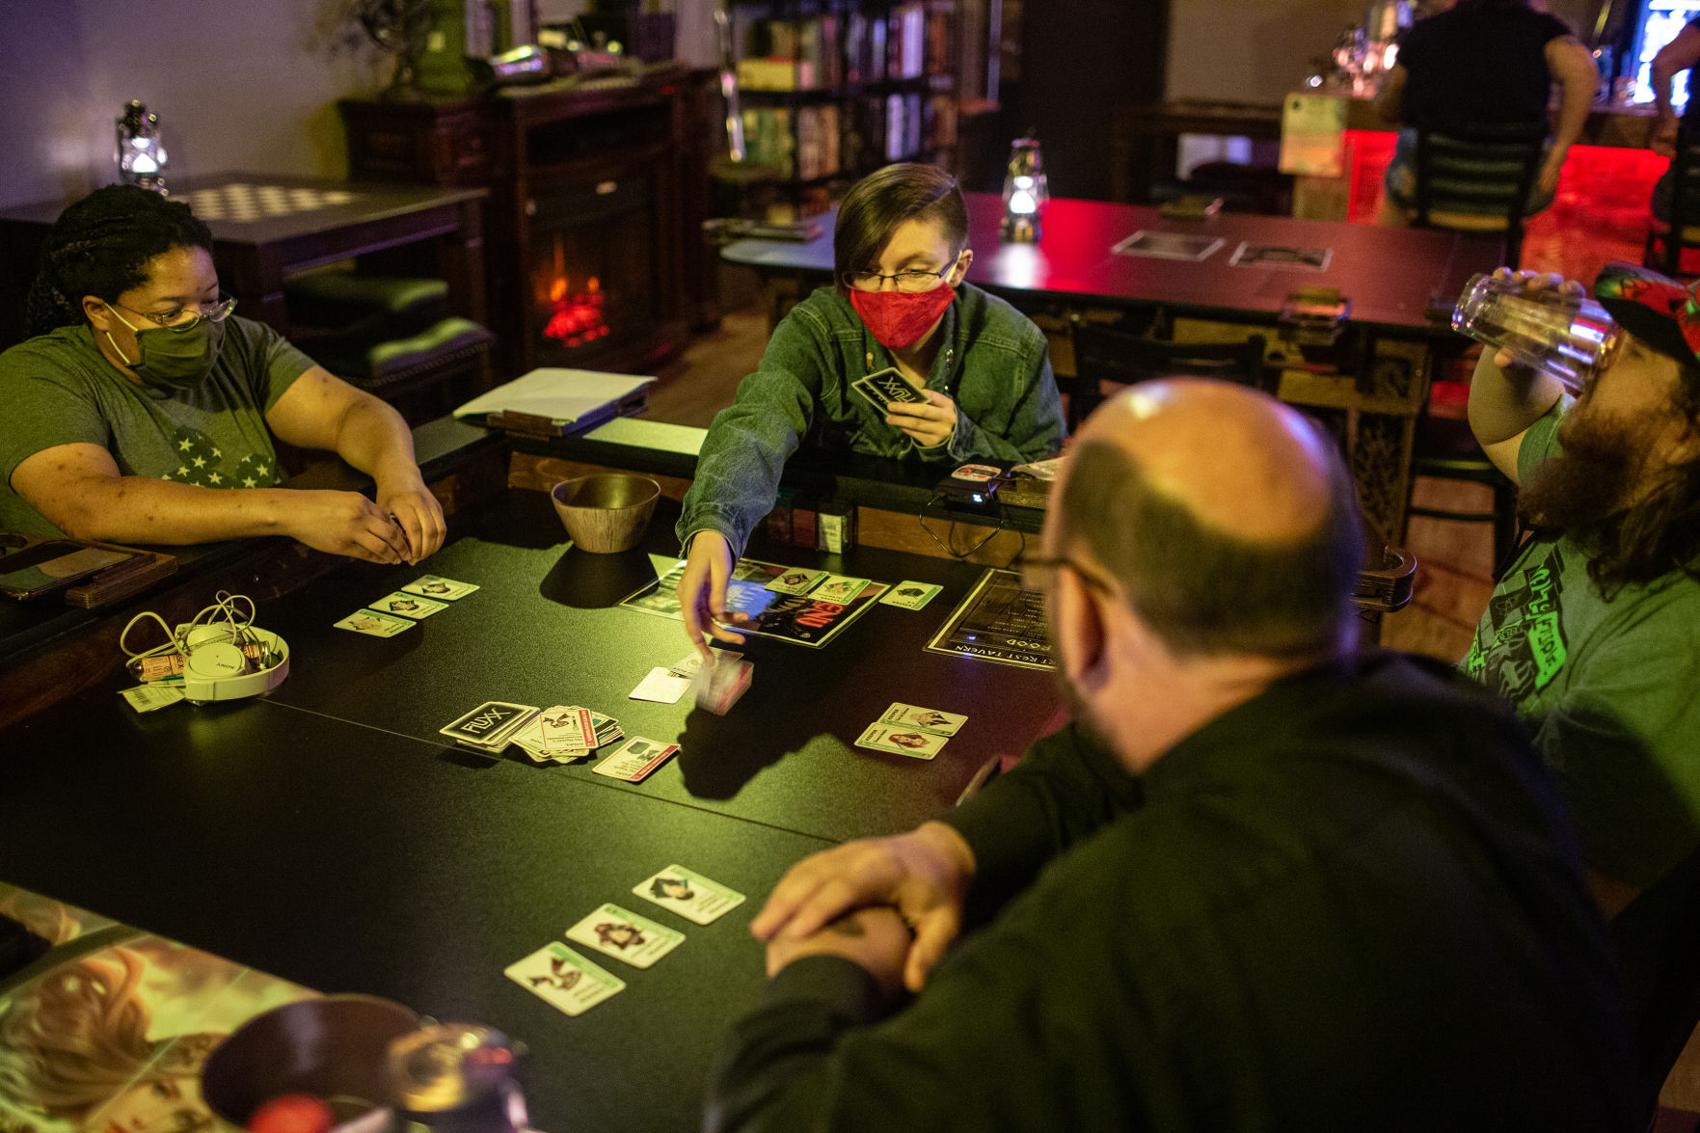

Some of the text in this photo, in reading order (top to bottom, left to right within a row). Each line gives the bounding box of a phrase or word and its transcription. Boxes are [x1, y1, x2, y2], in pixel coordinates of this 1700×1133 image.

[954, 645, 1002, 657] TAVERN
[1006, 639, 1052, 651] FOOD
[1007, 653, 1038, 663] REST
[460, 707, 511, 734] FLUXX
